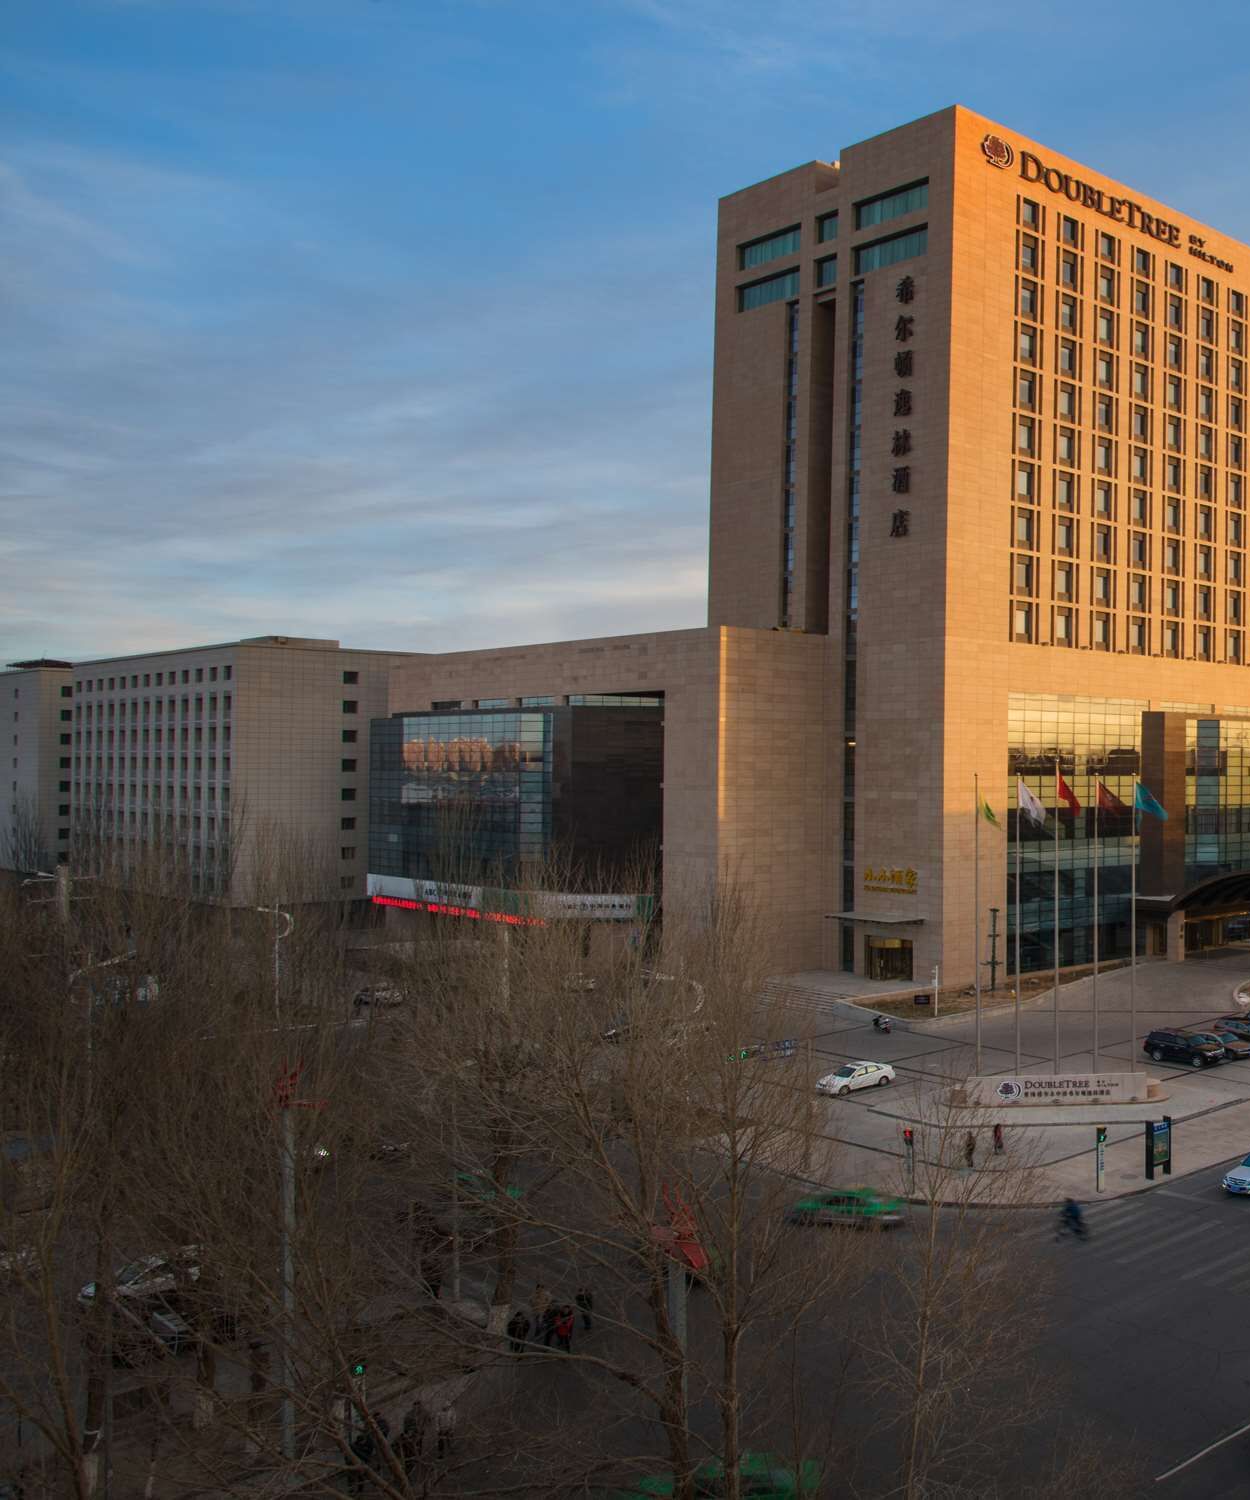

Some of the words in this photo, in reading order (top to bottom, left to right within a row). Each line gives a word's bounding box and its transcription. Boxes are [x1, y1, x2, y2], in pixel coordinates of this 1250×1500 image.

[1019, 150, 1181, 248] DOUBLETREE
[1187, 234, 1205, 248] BY
[1187, 246, 1234, 273] HILTON
[890, 275, 915, 538] 希尔顿逸林酒店
[1024, 1079, 1090, 1090] DOUBLETREE
